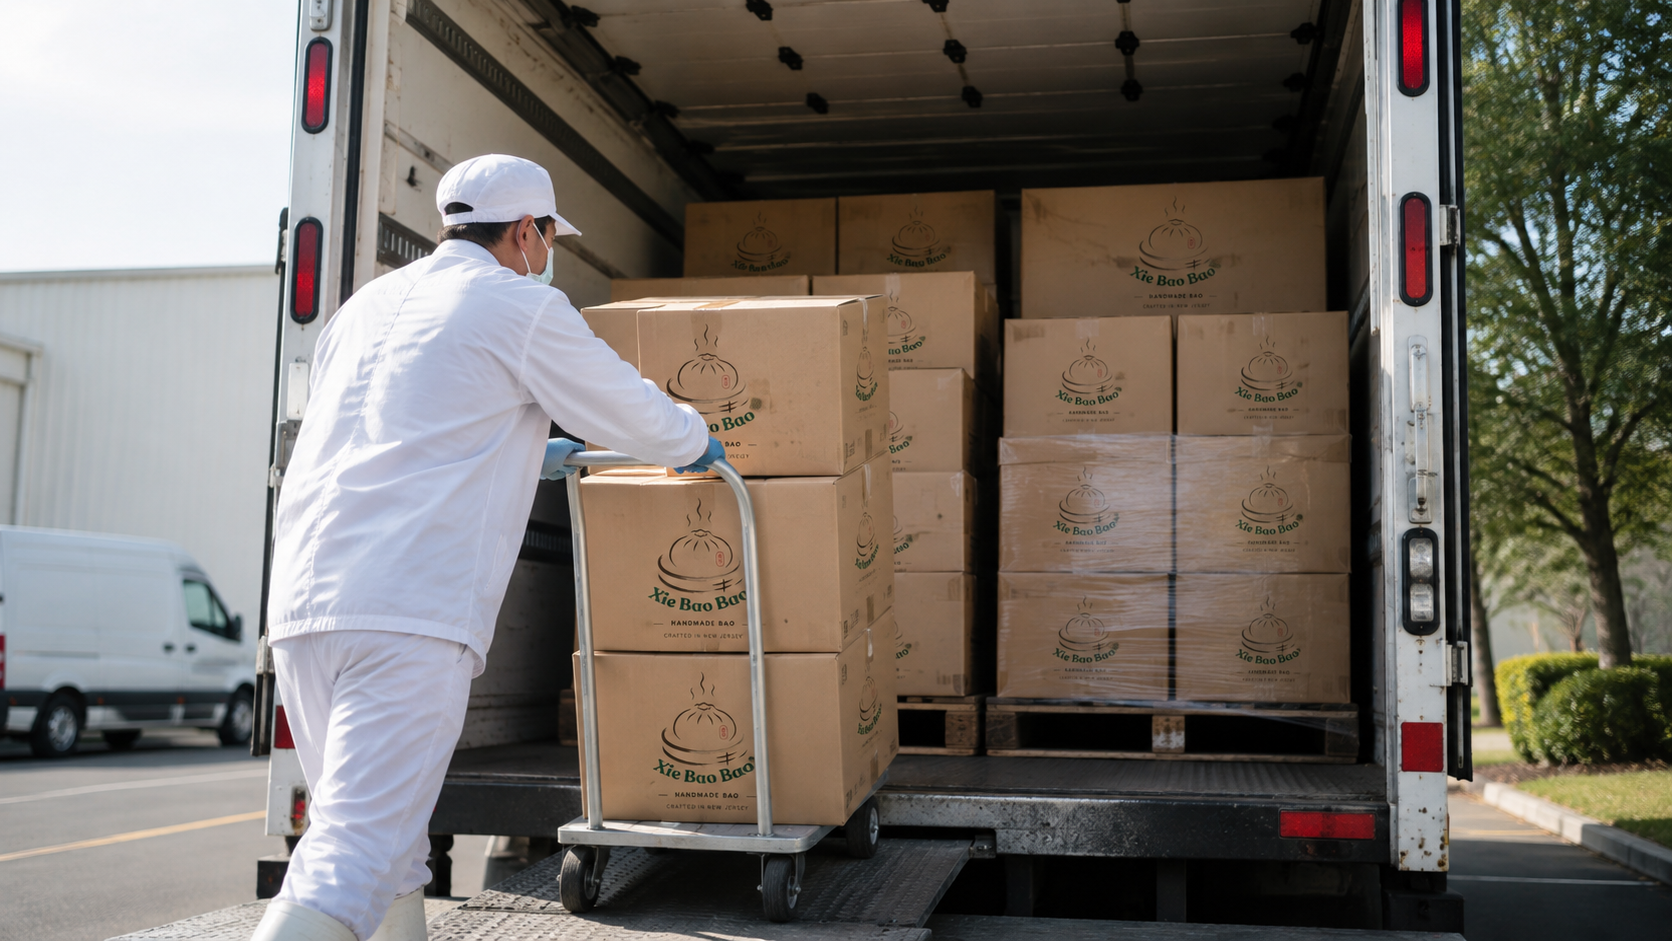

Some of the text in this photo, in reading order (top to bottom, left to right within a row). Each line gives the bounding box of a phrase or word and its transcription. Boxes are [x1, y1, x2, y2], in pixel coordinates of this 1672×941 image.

[1130, 266, 1216, 287] Xie Bao Bao
[1074, 396, 1096, 406] Bao
[1097, 392, 1119, 404] Bao
[1254, 393, 1275, 403] Bao
[1276, 388, 1298, 401] Bao
[721, 412, 755, 431] Bao
[1073, 526, 1093, 536] Bao
[1095, 521, 1116, 534] Bao
[1255, 526, 1276, 535] Bao
[648, 586, 747, 612] Xie Bao Bao
[1072, 654, 1092, 663] Bao
[1094, 650, 1115, 662] Bao
[1255, 656, 1276, 664] Bao
[653, 759, 754, 784] Xie Bao Bao
